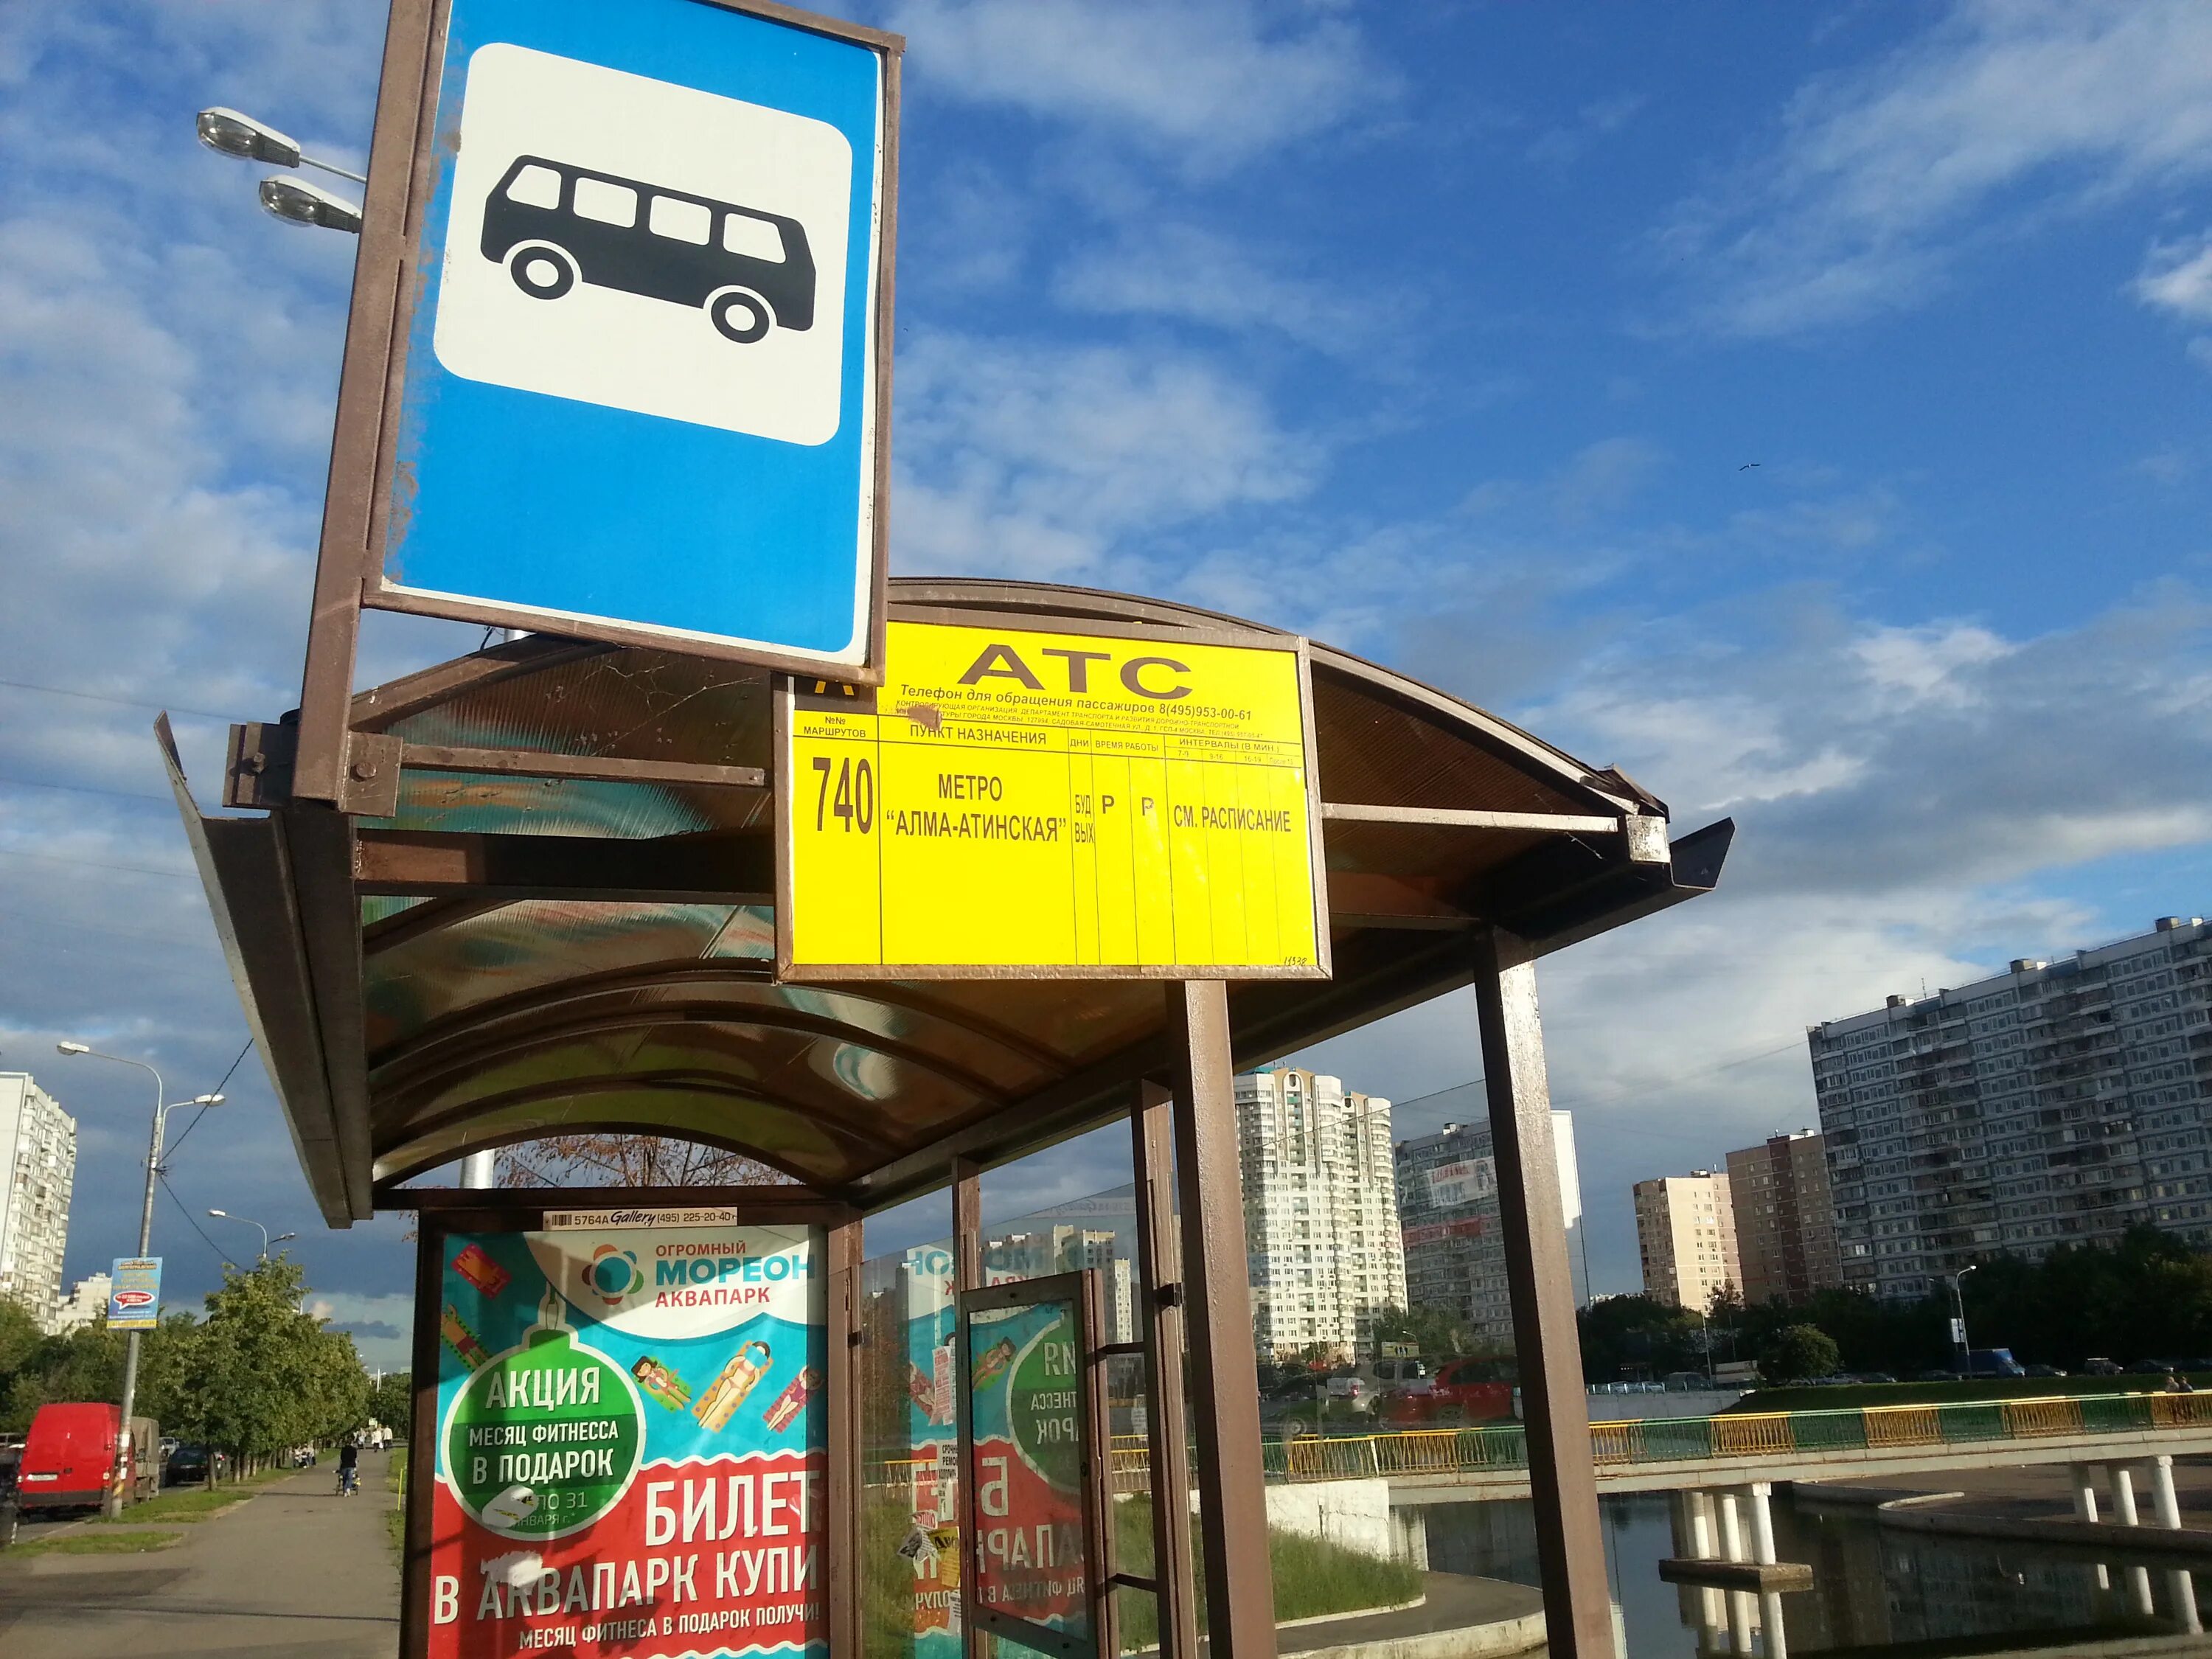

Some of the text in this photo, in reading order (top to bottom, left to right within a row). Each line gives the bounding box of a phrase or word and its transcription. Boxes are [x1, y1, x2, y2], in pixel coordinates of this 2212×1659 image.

[956, 643, 1193, 700] АТС
[901, 684, 1252, 721] Телефон для обращения пассажиров 8(495)953-00-61
[1020, 708, 1070, 717] ДЕПАРТАМЕНТ
[1071, 712, 1114, 721] ТРАНСПОРТА
[803, 726, 866, 738] МАРШРУТОВ
[824, 715, 846, 725] №№
[910, 724, 1047, 745] ПУНКТ НАЗНАЧЕНИЯ
[1069, 738, 1089, 748] ДНИ
[1095, 740, 1158, 751] ВРЕМЯ РАБОТЫ
[1179, 738, 1239, 750] ИНТЕРВАЛЫ
[813, 757, 873, 835] 740
[938, 773, 1003, 801] МЕТРО
[1075, 793, 1091, 818] БУД
[1102, 794, 1115, 814] Р
[1173, 804, 1291, 832] СМ. РАСПИСАНИЕ
[1075, 821, 1094, 844] ВЫХ
[611, 1210, 655, 1228] Gallery
[657, 1213, 680, 1224] (495)
[684, 1211, 731, 1222] 225-20-40
[655, 1239, 746, 1256] ОГРОМНЫЙ
[655, 1254, 815, 1286] МОРЕОН
[655, 1287, 771, 1308] АКВАПАРК
[484, 1366, 600, 1412] АКЦИЯ
[469, 1420, 619, 1447] МЕСЯЦ ФИТНЕССА
[473, 1447, 614, 1485] В ПОДАРОК
[566, 1491, 588, 1509] 31
[644, 1470, 821, 1547] БИЛЕТ
[433, 1575, 459, 1625] В
[716, 1544, 818, 1600] КУПИ
[518, 1601, 821, 1651] МЕСЯЦ ФИТНЕСА В ПОДАРОК ПОЛУЧИ!
